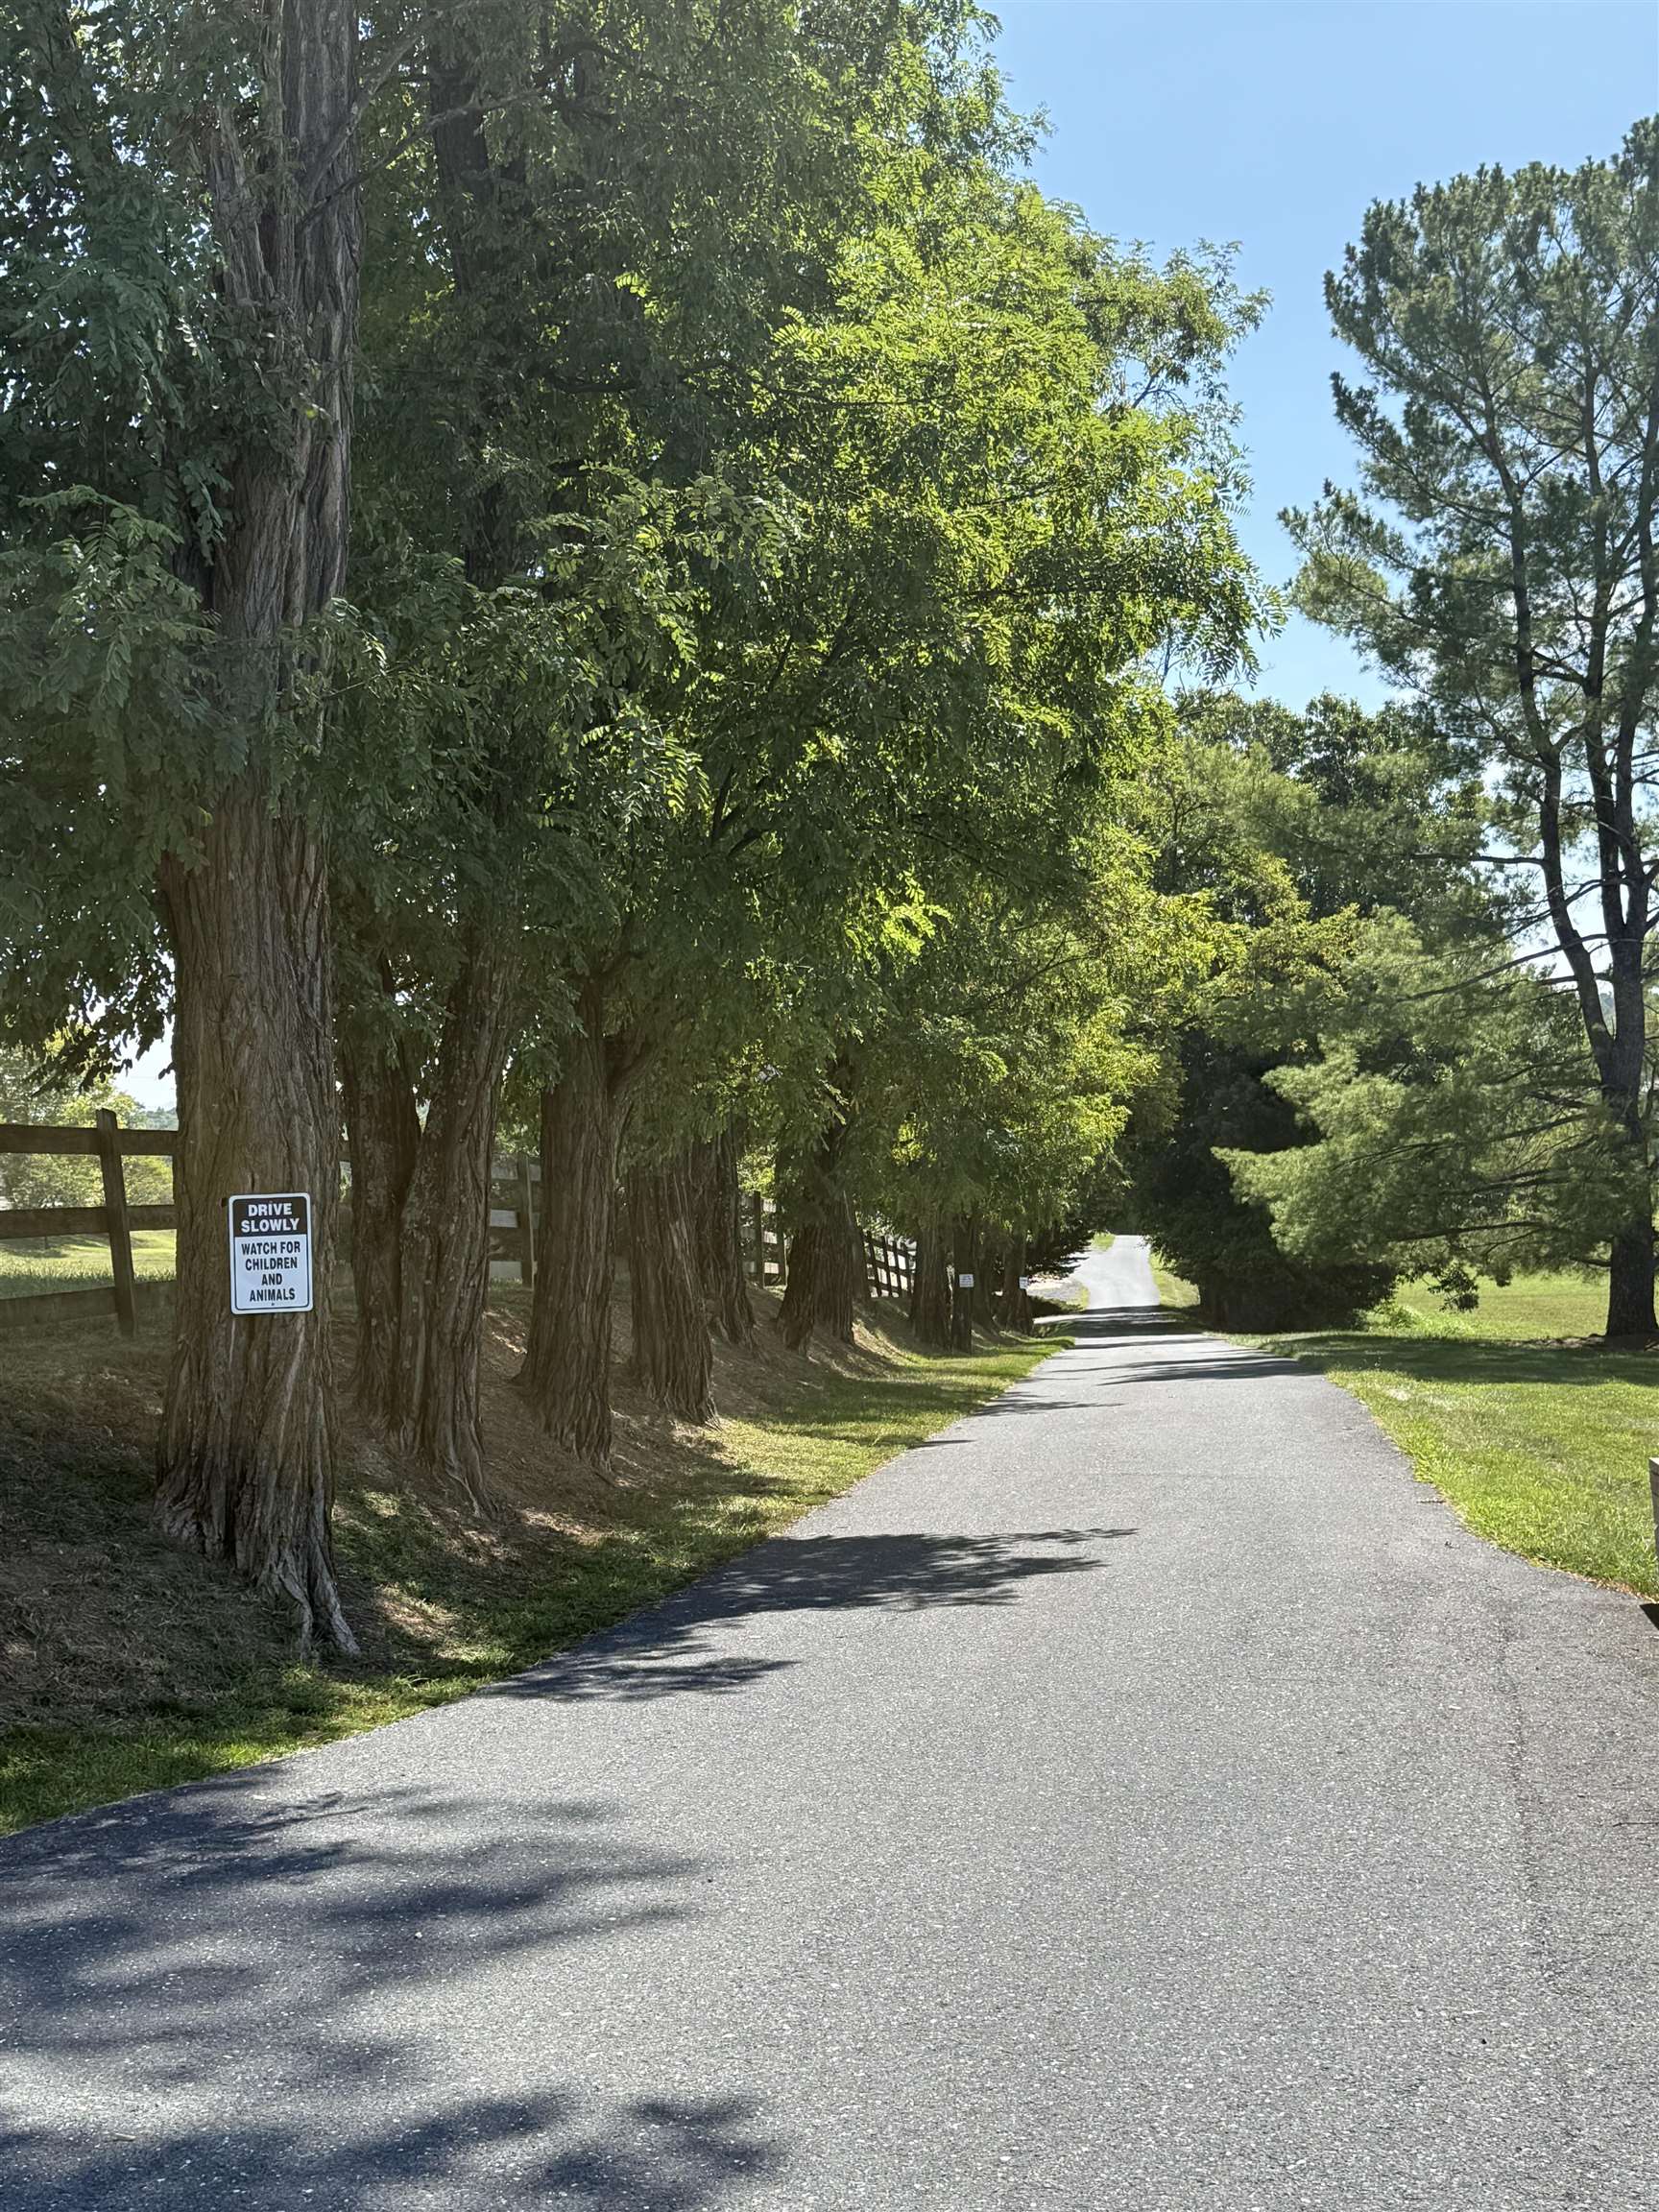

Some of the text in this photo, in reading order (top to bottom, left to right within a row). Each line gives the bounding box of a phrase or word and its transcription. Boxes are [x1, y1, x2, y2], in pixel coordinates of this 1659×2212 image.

[248, 1203, 293, 1216] DRIVE
[241, 1217, 300, 1233] SLOWLY
[241, 1240, 301, 1256] WATCH FOR
[245, 1257, 298, 1271] CHILDREN
[261, 1273, 283, 1286] AND
[250, 1287, 296, 1302] ANIMALS
